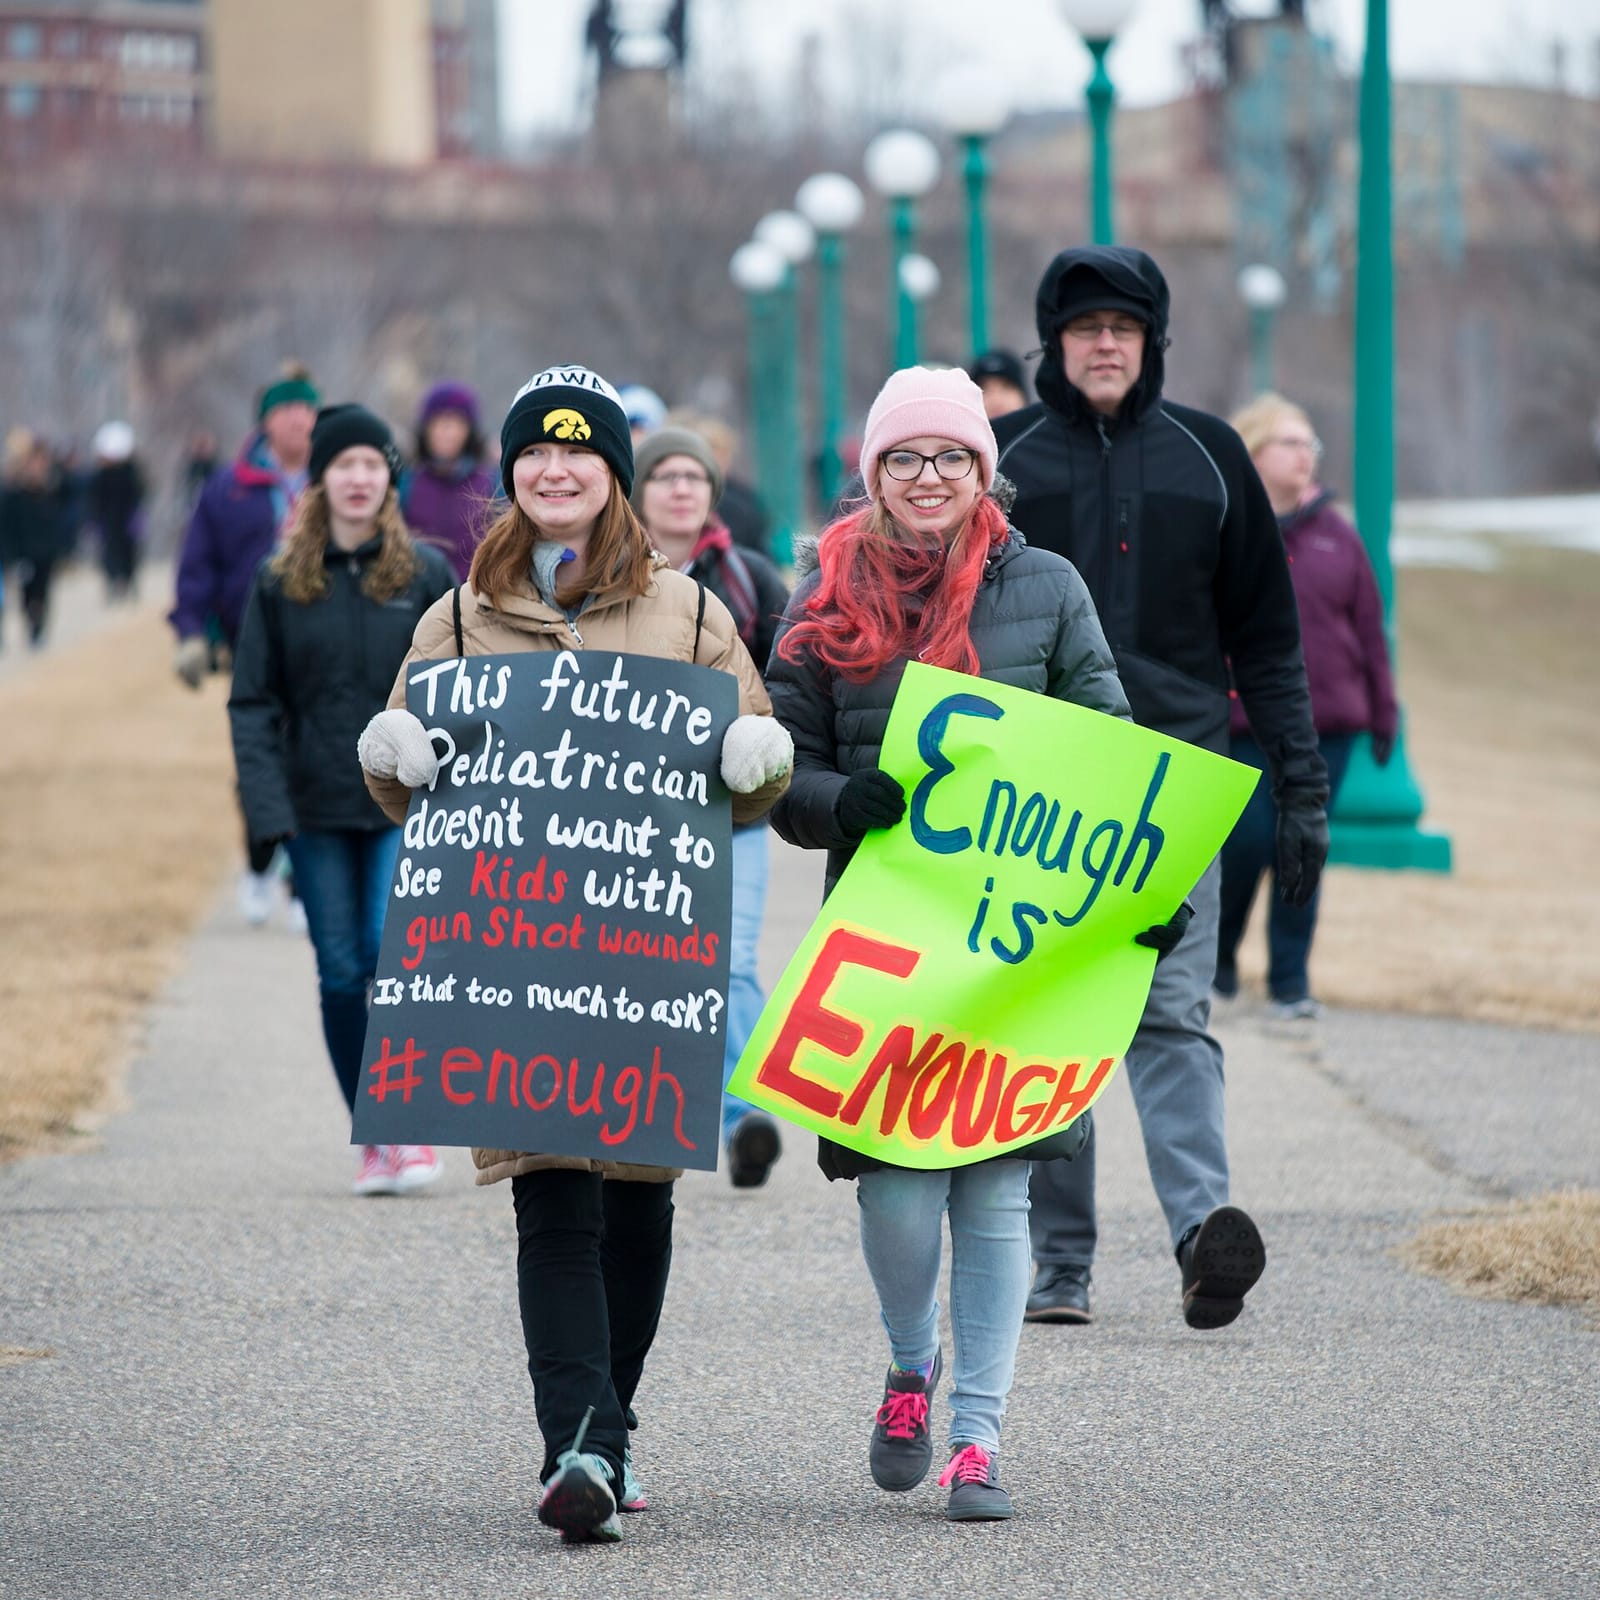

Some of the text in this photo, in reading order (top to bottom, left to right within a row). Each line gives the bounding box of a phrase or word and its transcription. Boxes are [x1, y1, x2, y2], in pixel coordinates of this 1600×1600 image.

[408, 650, 713, 746] This future
[425, 720, 709, 807] Pediatrician
[546, 812, 660, 858] want
[669, 822, 715, 869] to
[909, 691, 1172, 927] Enough
[470, 849, 569, 904] Kids
[583, 865, 694, 925] with
[967, 876, 1048, 965] is
[401, 911, 472, 971] gun
[598, 923, 720, 967] wounds
[373, 973, 725, 1035] Is that too much to ask?
[755, 927, 1115, 1148] ENOUGH
[367, 1037, 698, 1151] #enough
